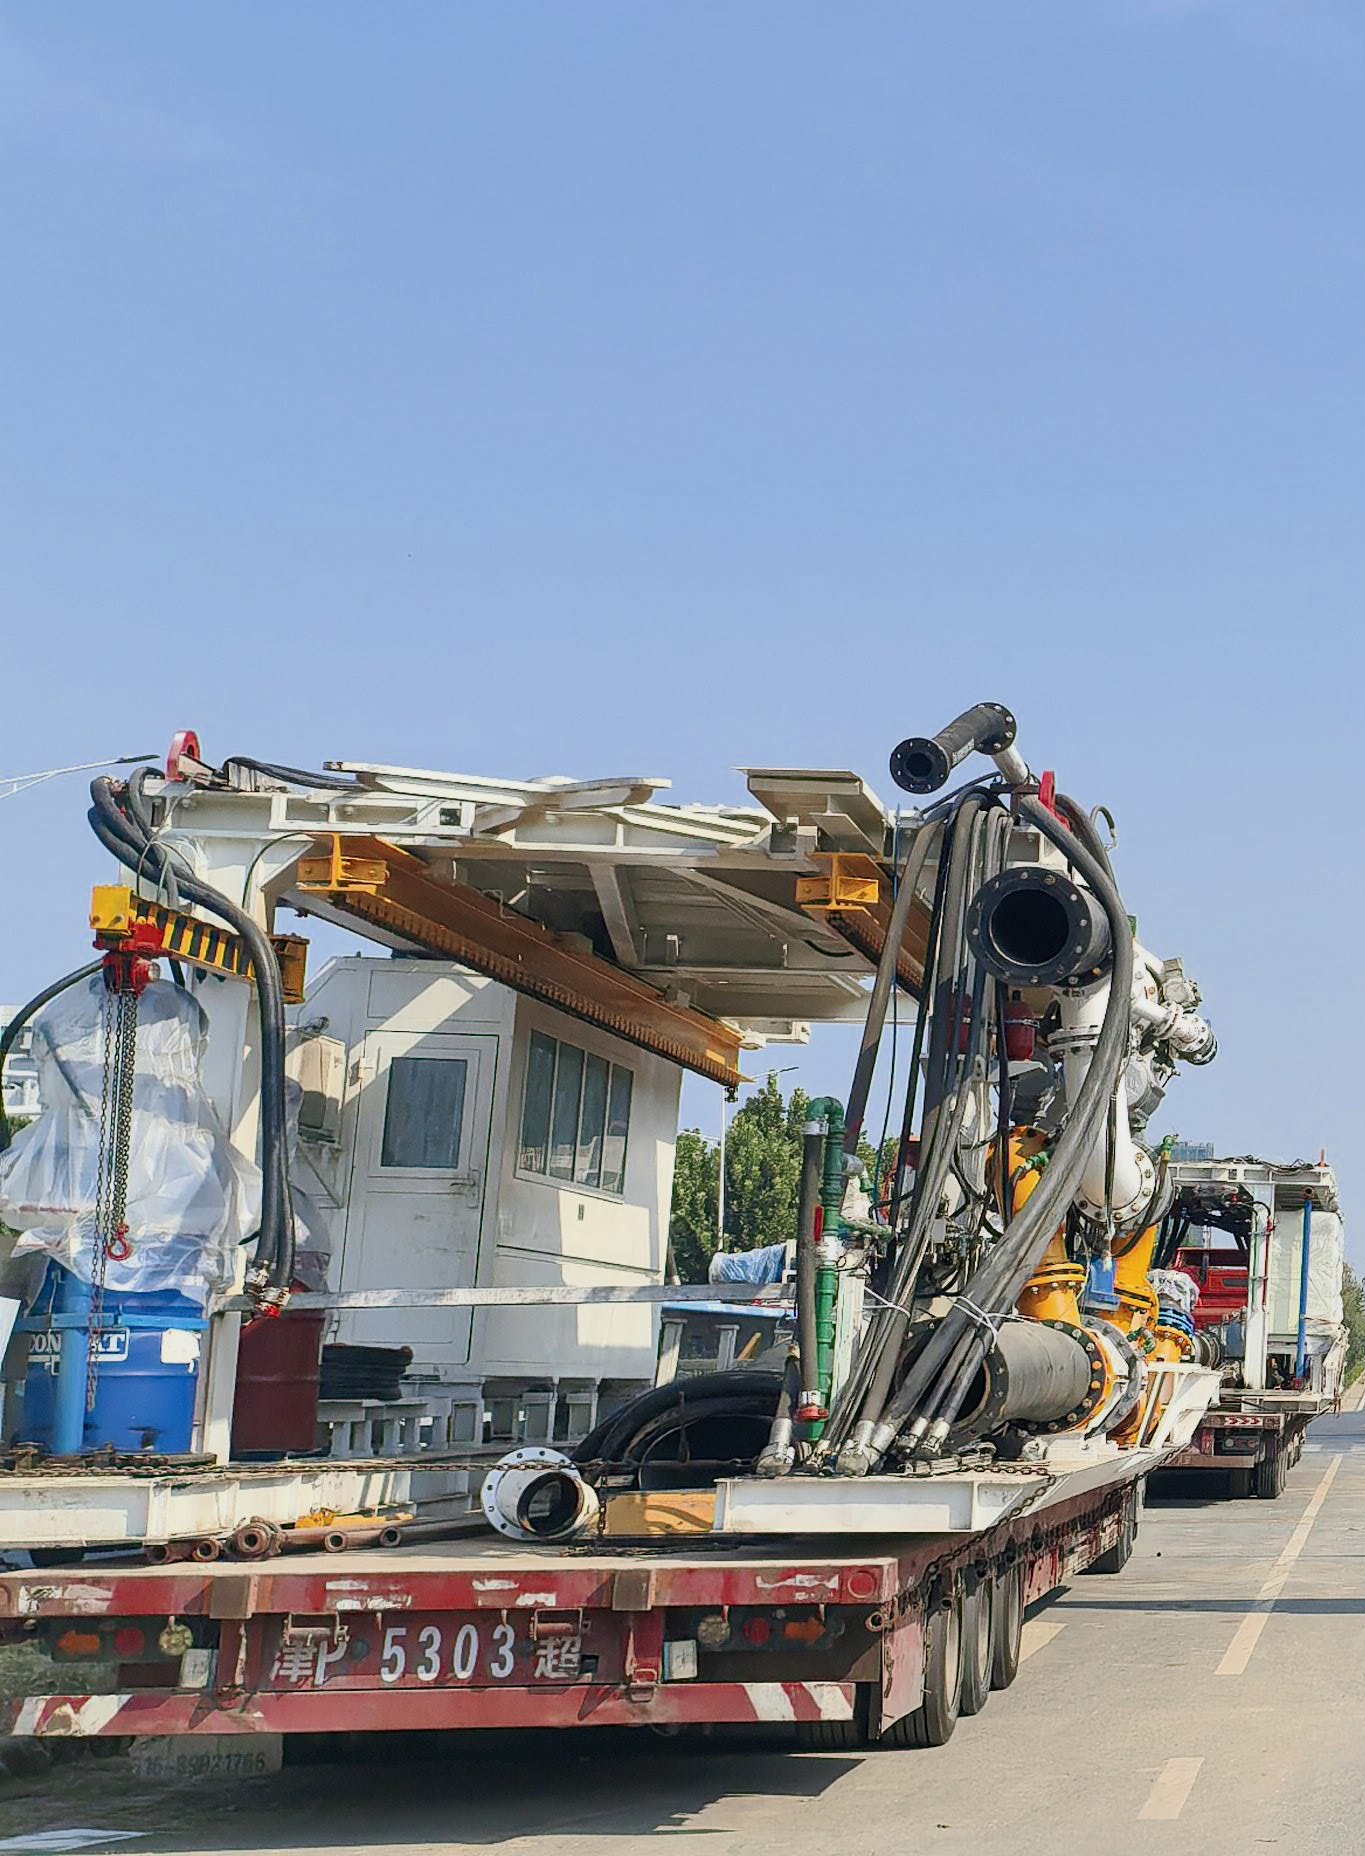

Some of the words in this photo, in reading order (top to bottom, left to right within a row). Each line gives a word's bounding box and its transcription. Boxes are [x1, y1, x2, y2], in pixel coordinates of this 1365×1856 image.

[29, 1332, 126, 1354] ONAT
[380, 1622, 517, 1683] 5303
[533, 1635, 582, 1680] 超
